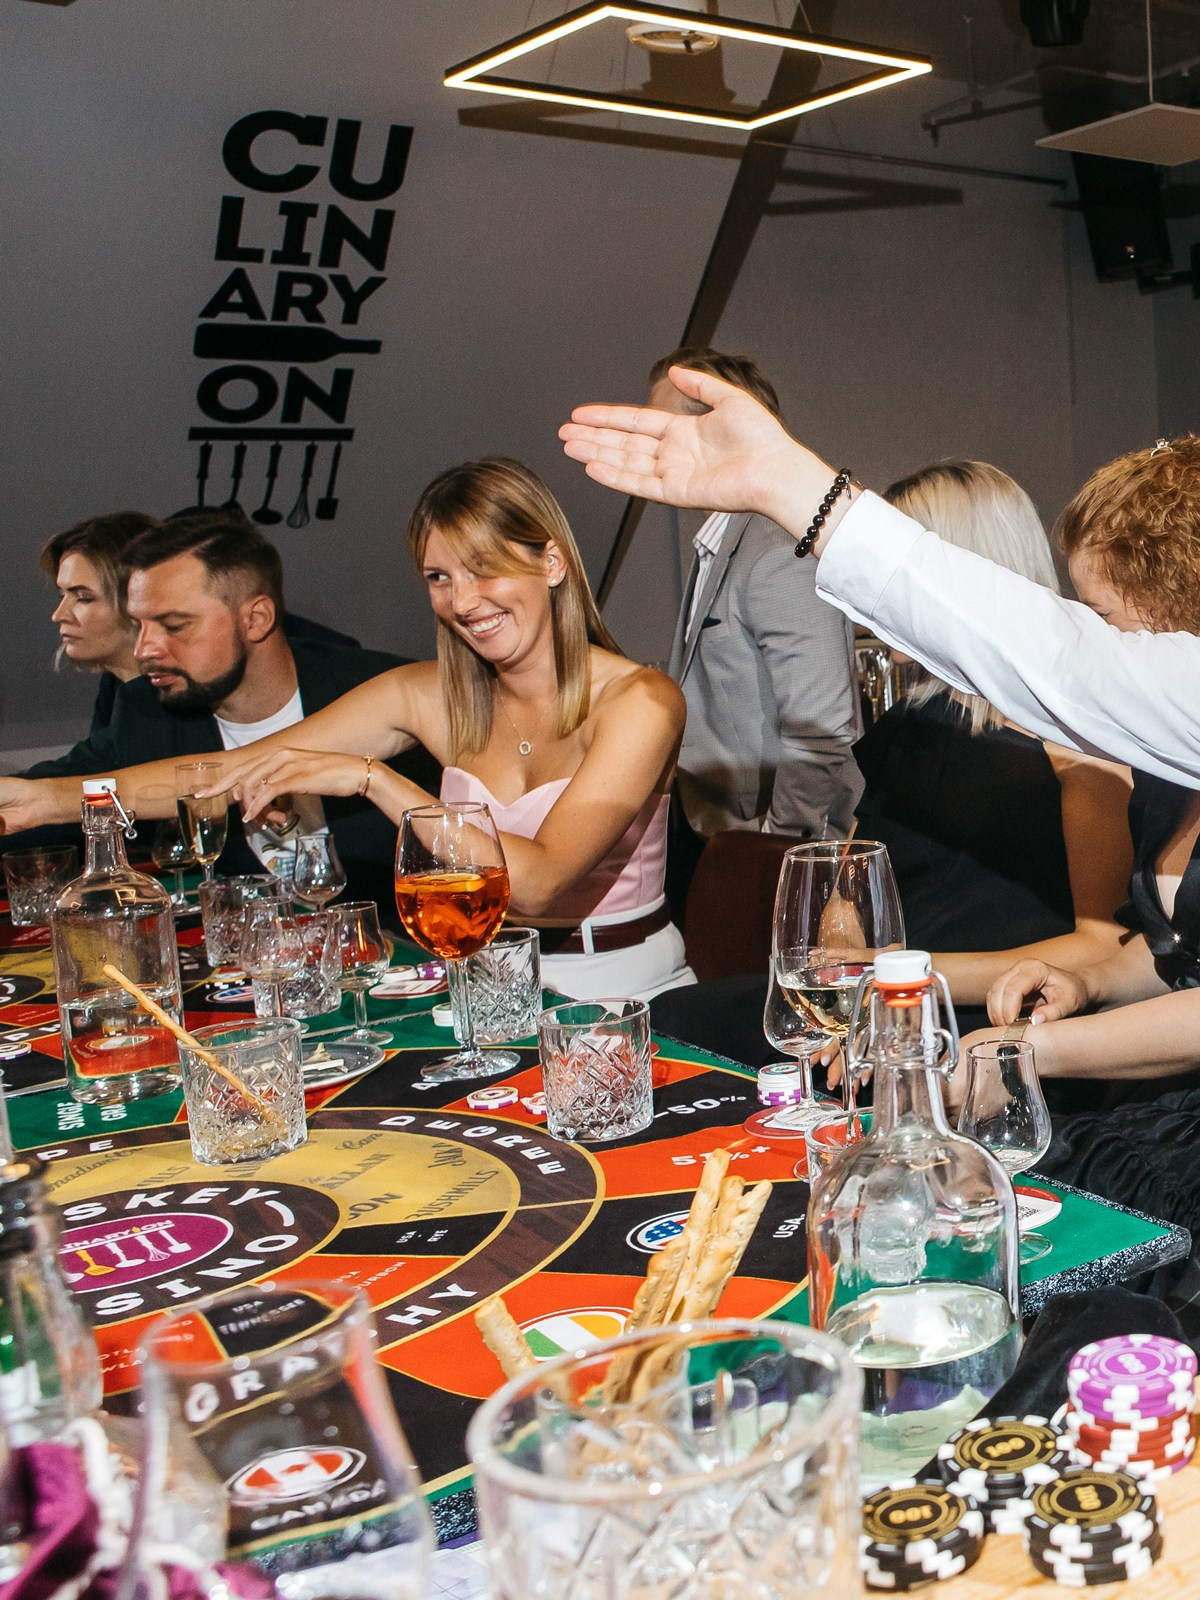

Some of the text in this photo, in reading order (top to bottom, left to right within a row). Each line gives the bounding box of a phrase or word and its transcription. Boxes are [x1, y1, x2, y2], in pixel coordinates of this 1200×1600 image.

[222, 110, 415, 201] CU
[214, 195, 396, 271] LIN
[198, 267, 387, 325] ARY
[197, 364, 355, 424] ON
[100, 1103, 127, 1122] GRA
[379, 1115, 565, 1175] DEGREE
[63, 1187, 281, 1222] SKEY
[64, 1230, 131, 1248] INARY
[396, 1230, 418, 1245] USA
[773, 1217, 802, 1239] USA
[96, 1234, 299, 1316] SINO
[354, 1261, 407, 1290] OURBON
[984, 1437, 1024, 1459] 100
[888, 1504, 933, 1525] 100
